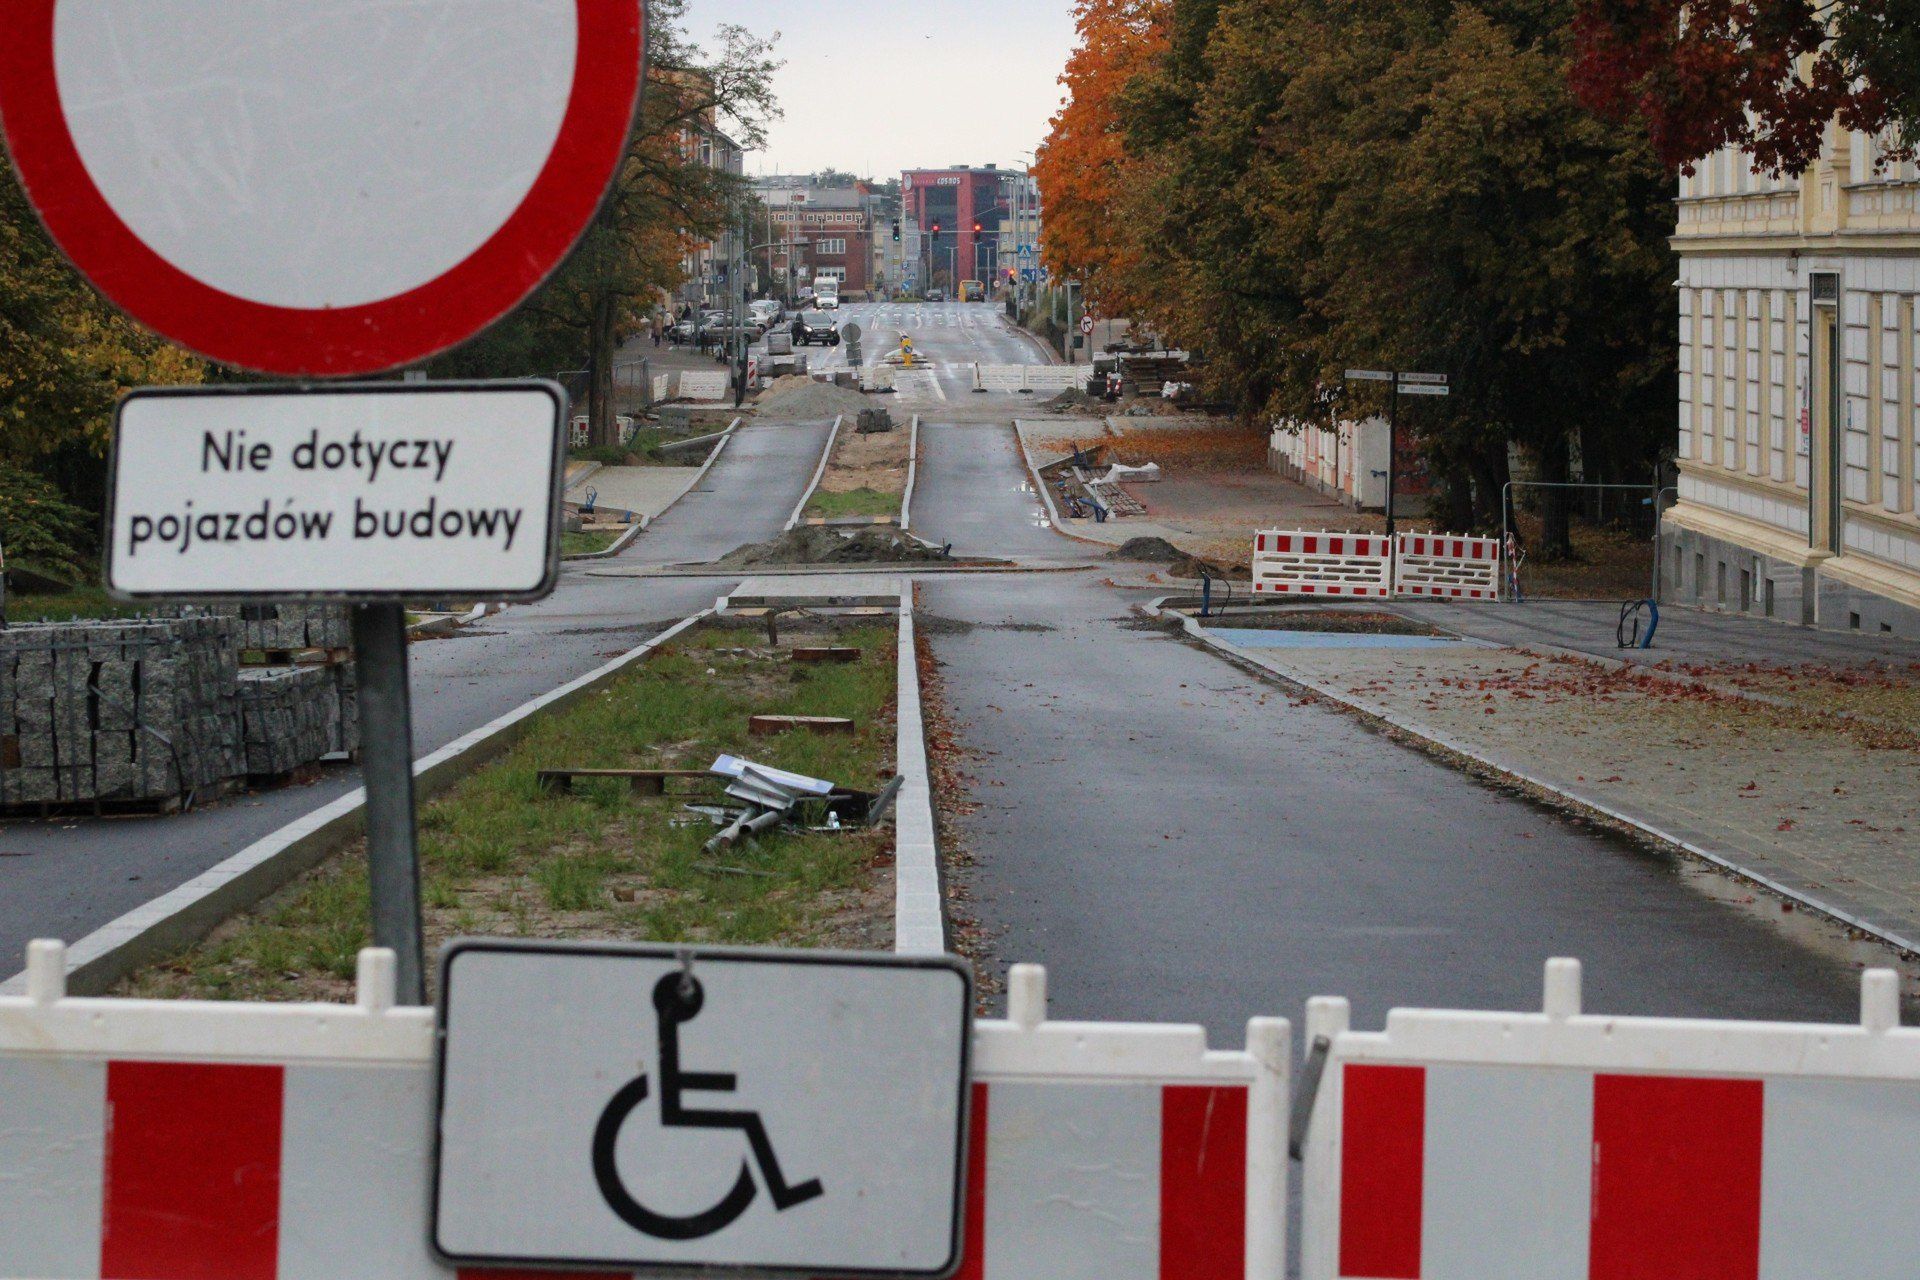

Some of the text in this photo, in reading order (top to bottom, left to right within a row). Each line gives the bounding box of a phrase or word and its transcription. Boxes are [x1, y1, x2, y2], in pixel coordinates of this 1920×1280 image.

[202, 428, 453, 482] Nie dotyczy
[129, 497, 522, 555] pojazdów budowy
